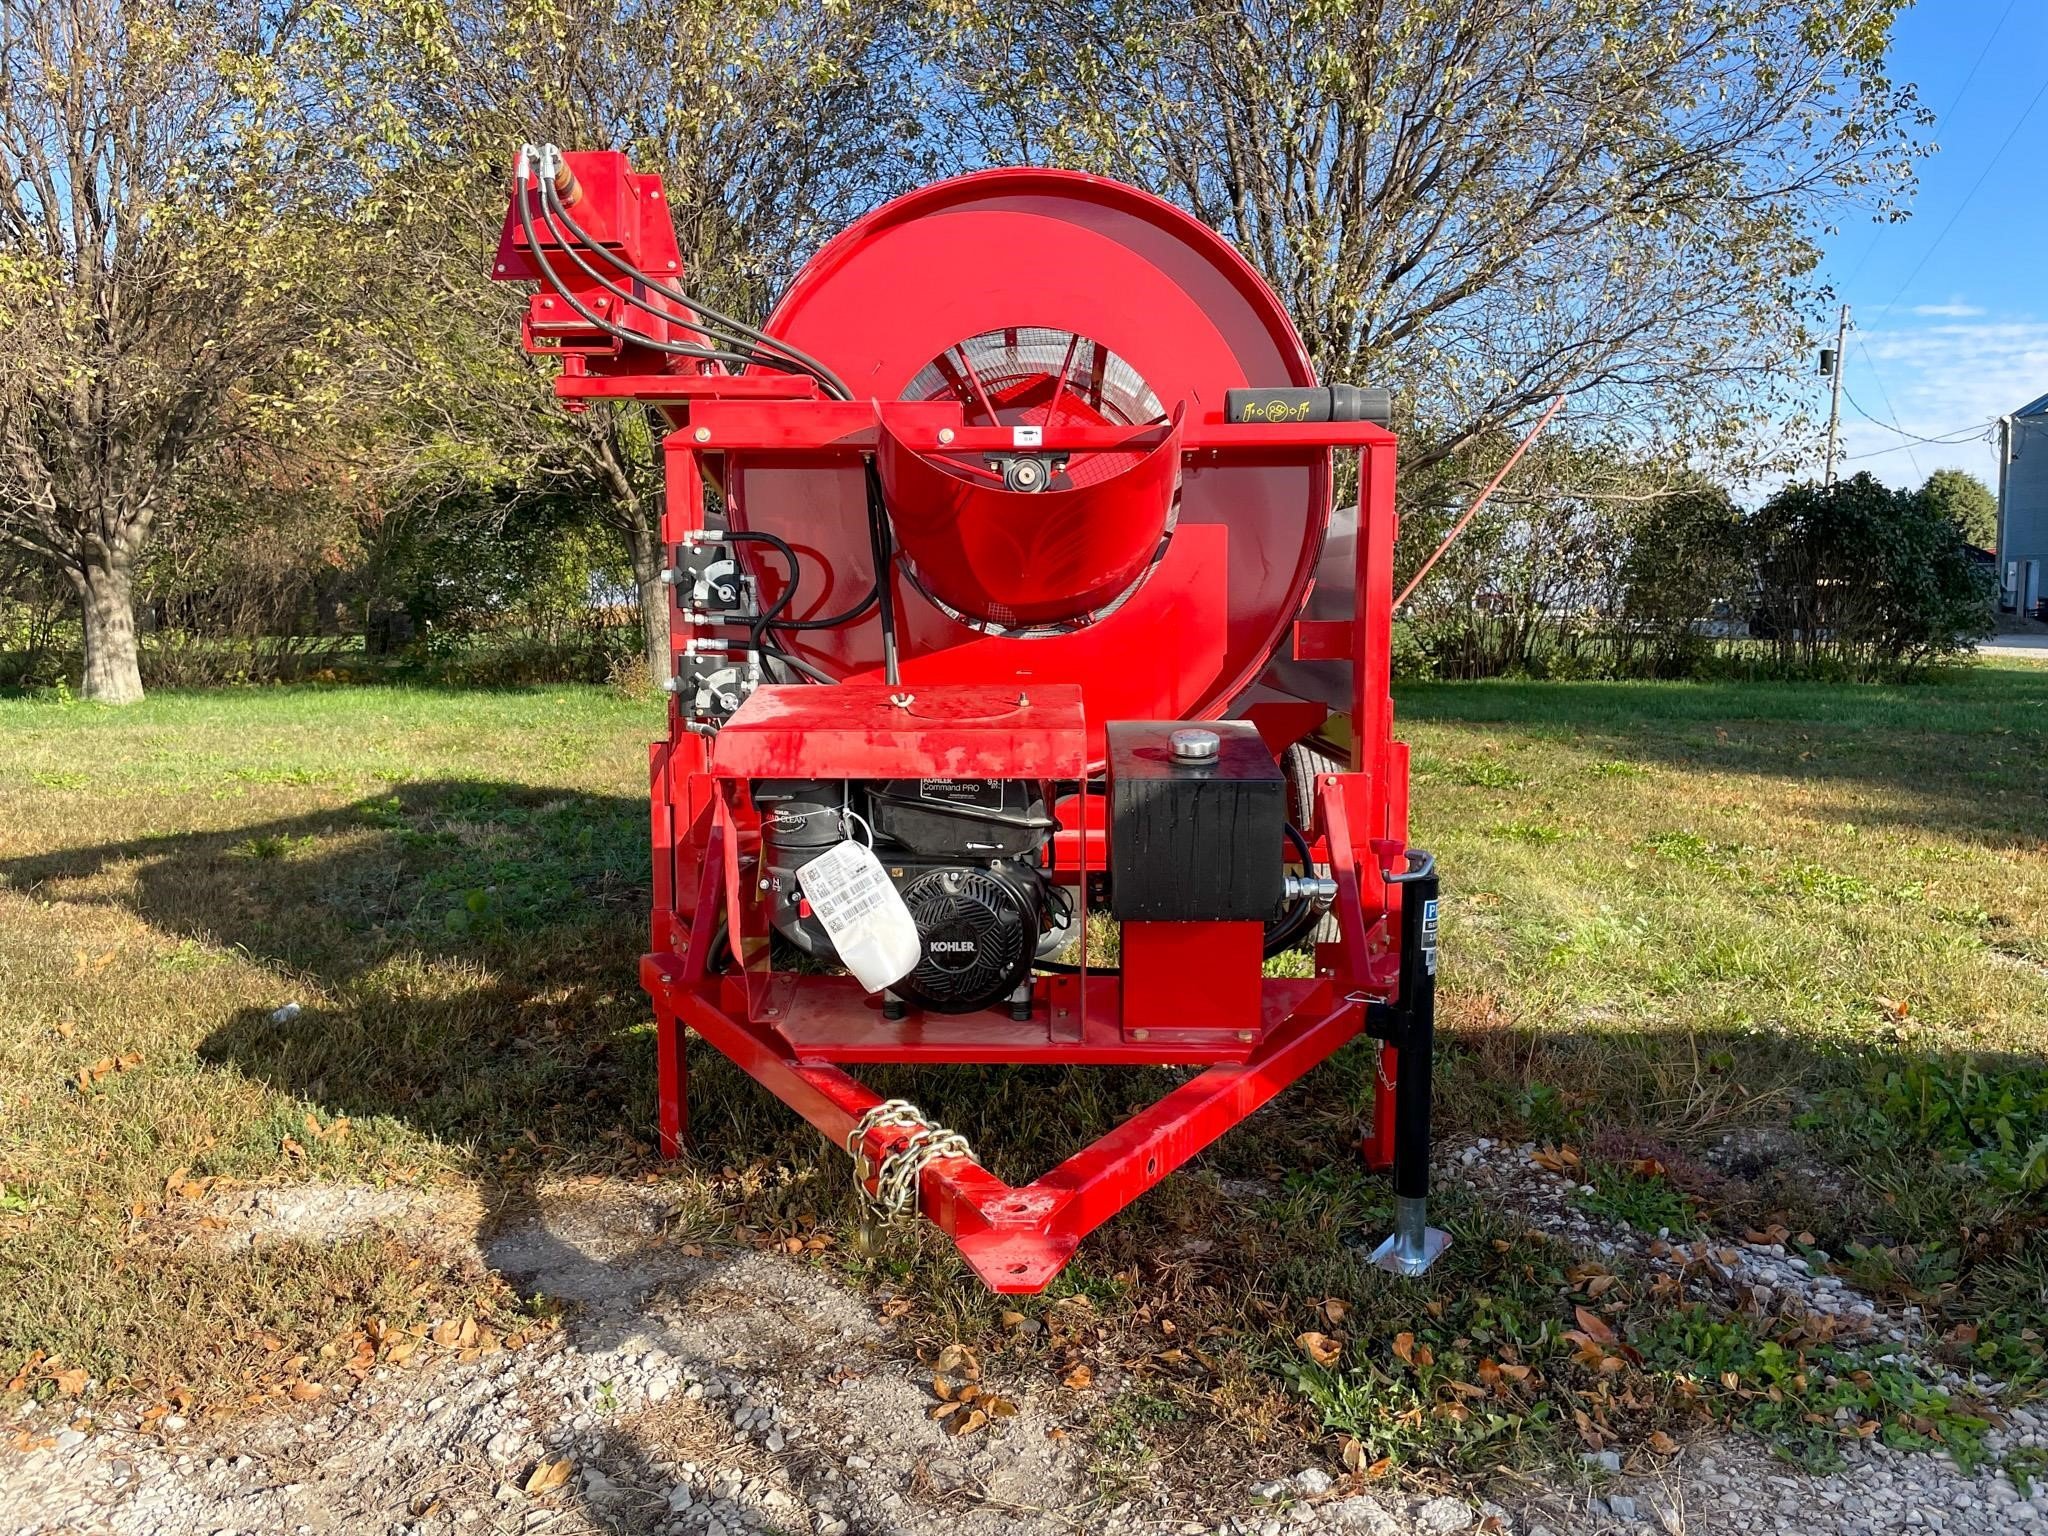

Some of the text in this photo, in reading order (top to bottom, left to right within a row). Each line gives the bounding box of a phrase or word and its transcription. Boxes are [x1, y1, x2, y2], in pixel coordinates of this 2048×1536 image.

[923, 783, 980, 792] Command PRO
[930, 941, 975, 952] KOHLER
